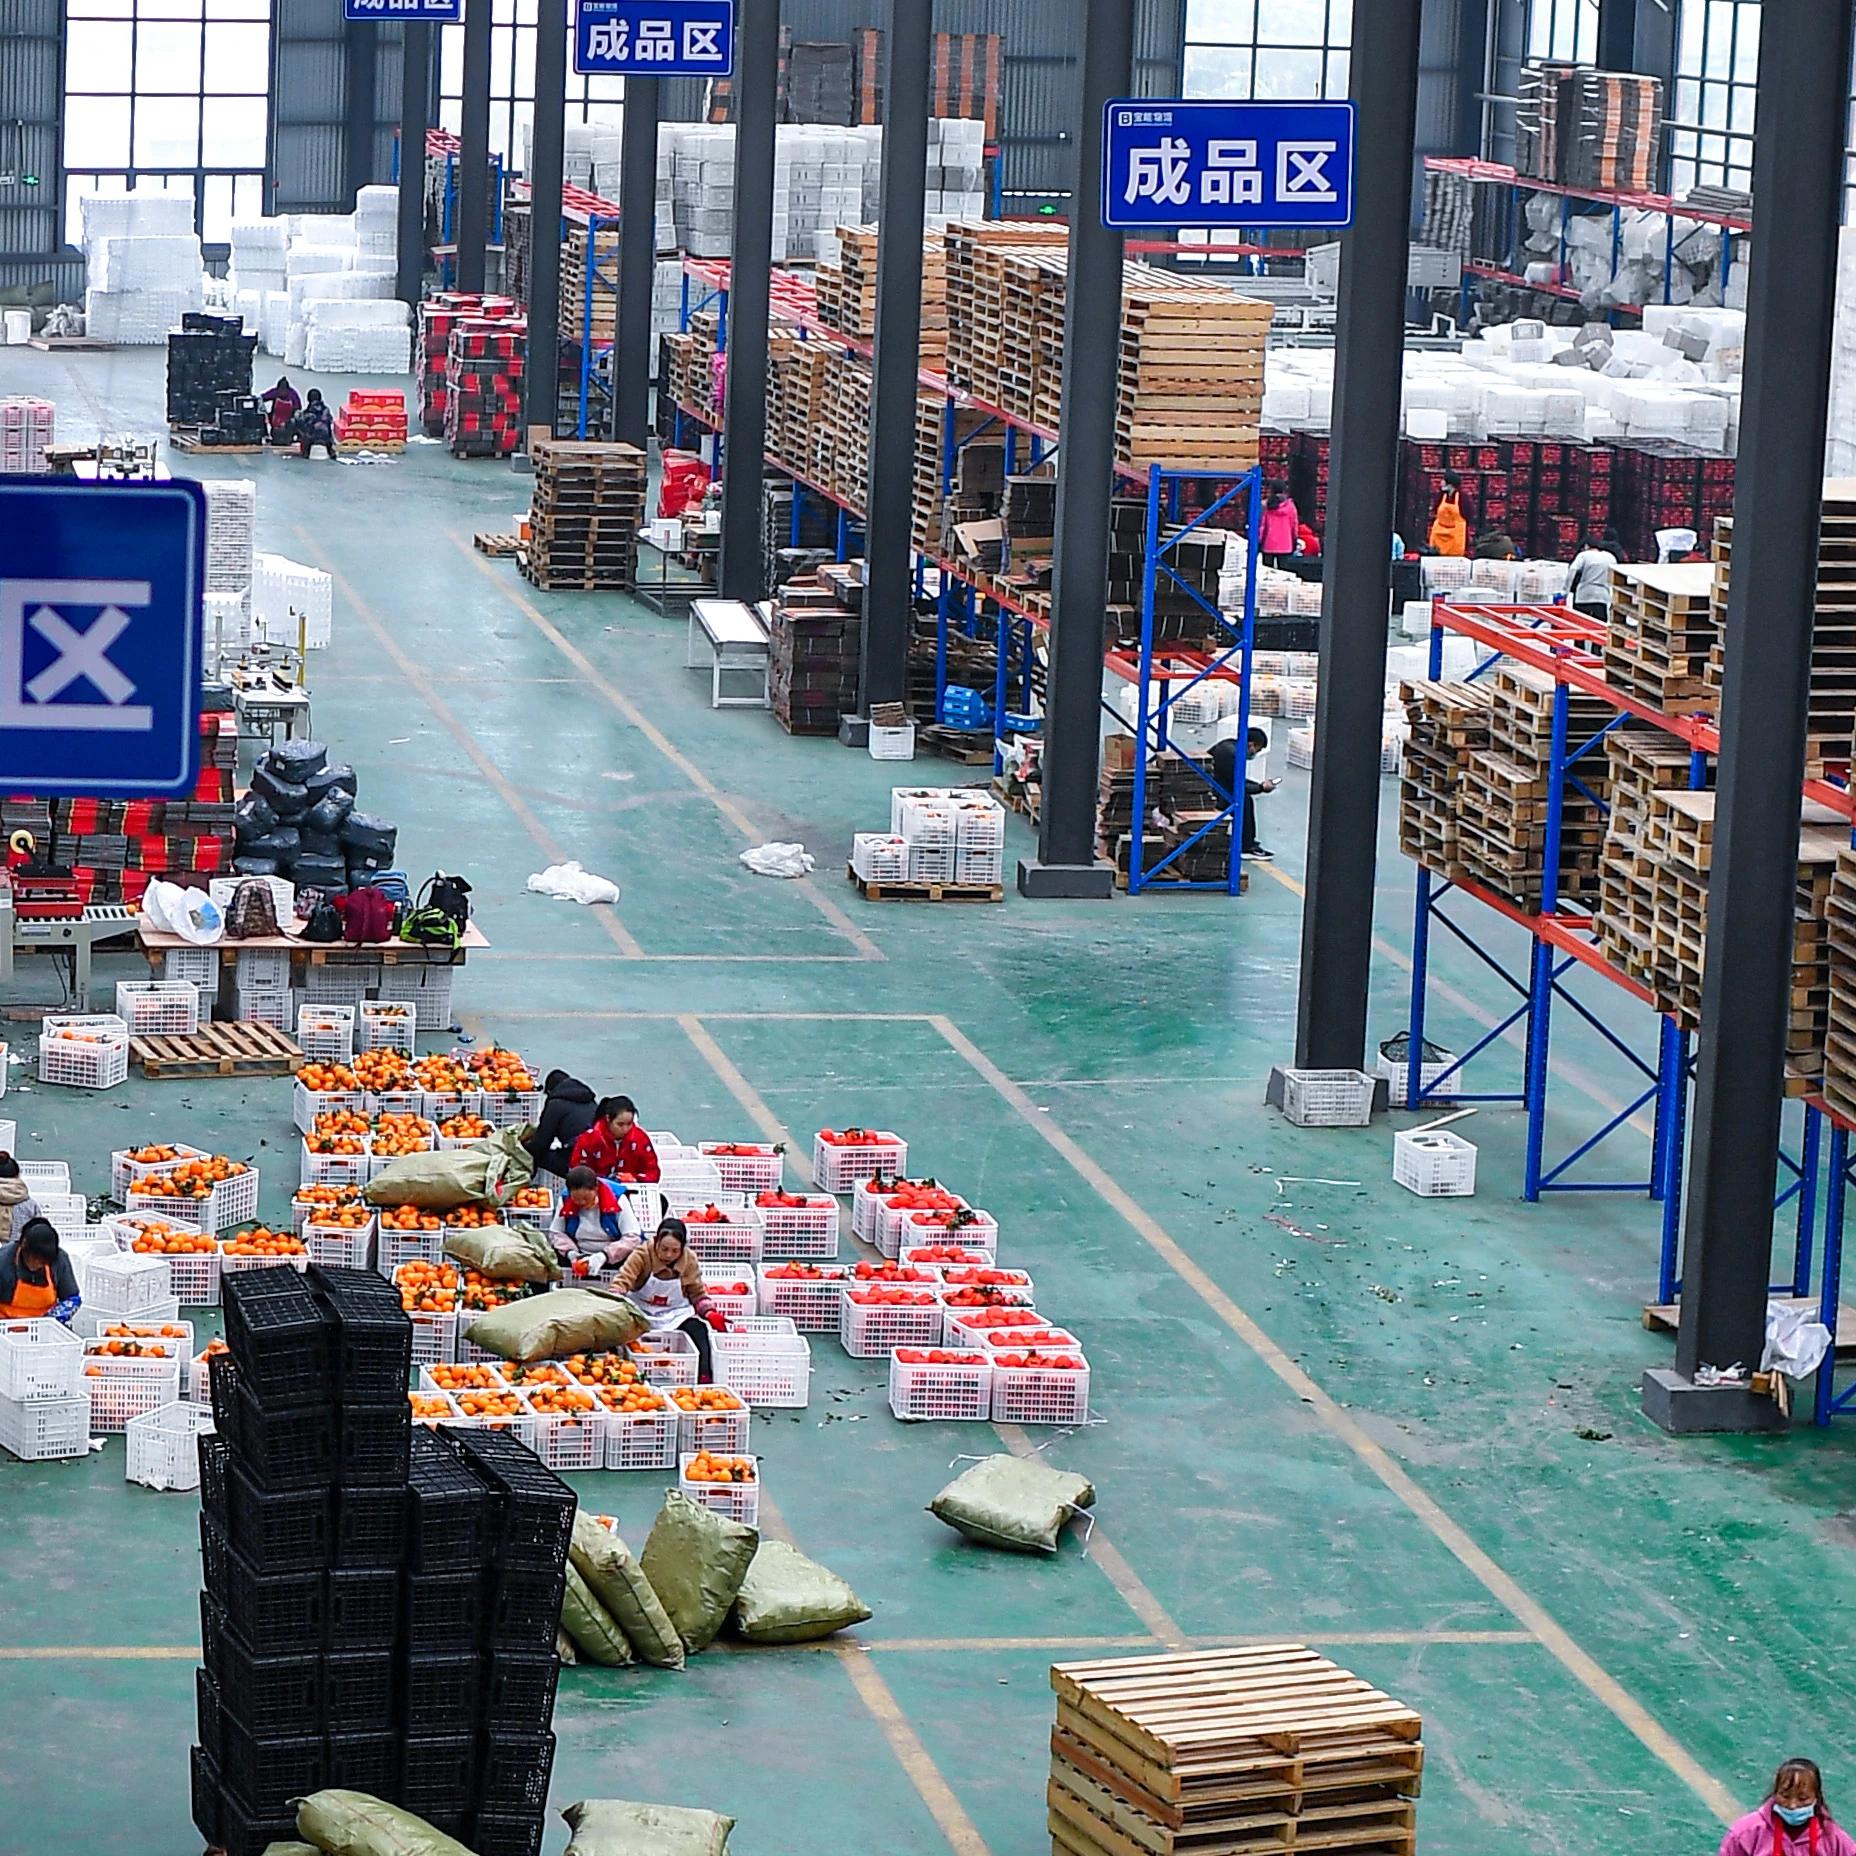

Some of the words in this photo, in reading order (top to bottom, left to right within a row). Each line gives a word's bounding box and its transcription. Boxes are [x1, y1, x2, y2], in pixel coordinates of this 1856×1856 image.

[587, 18, 723, 61] 成品区
[1123, 137, 1338, 205] 成品区
